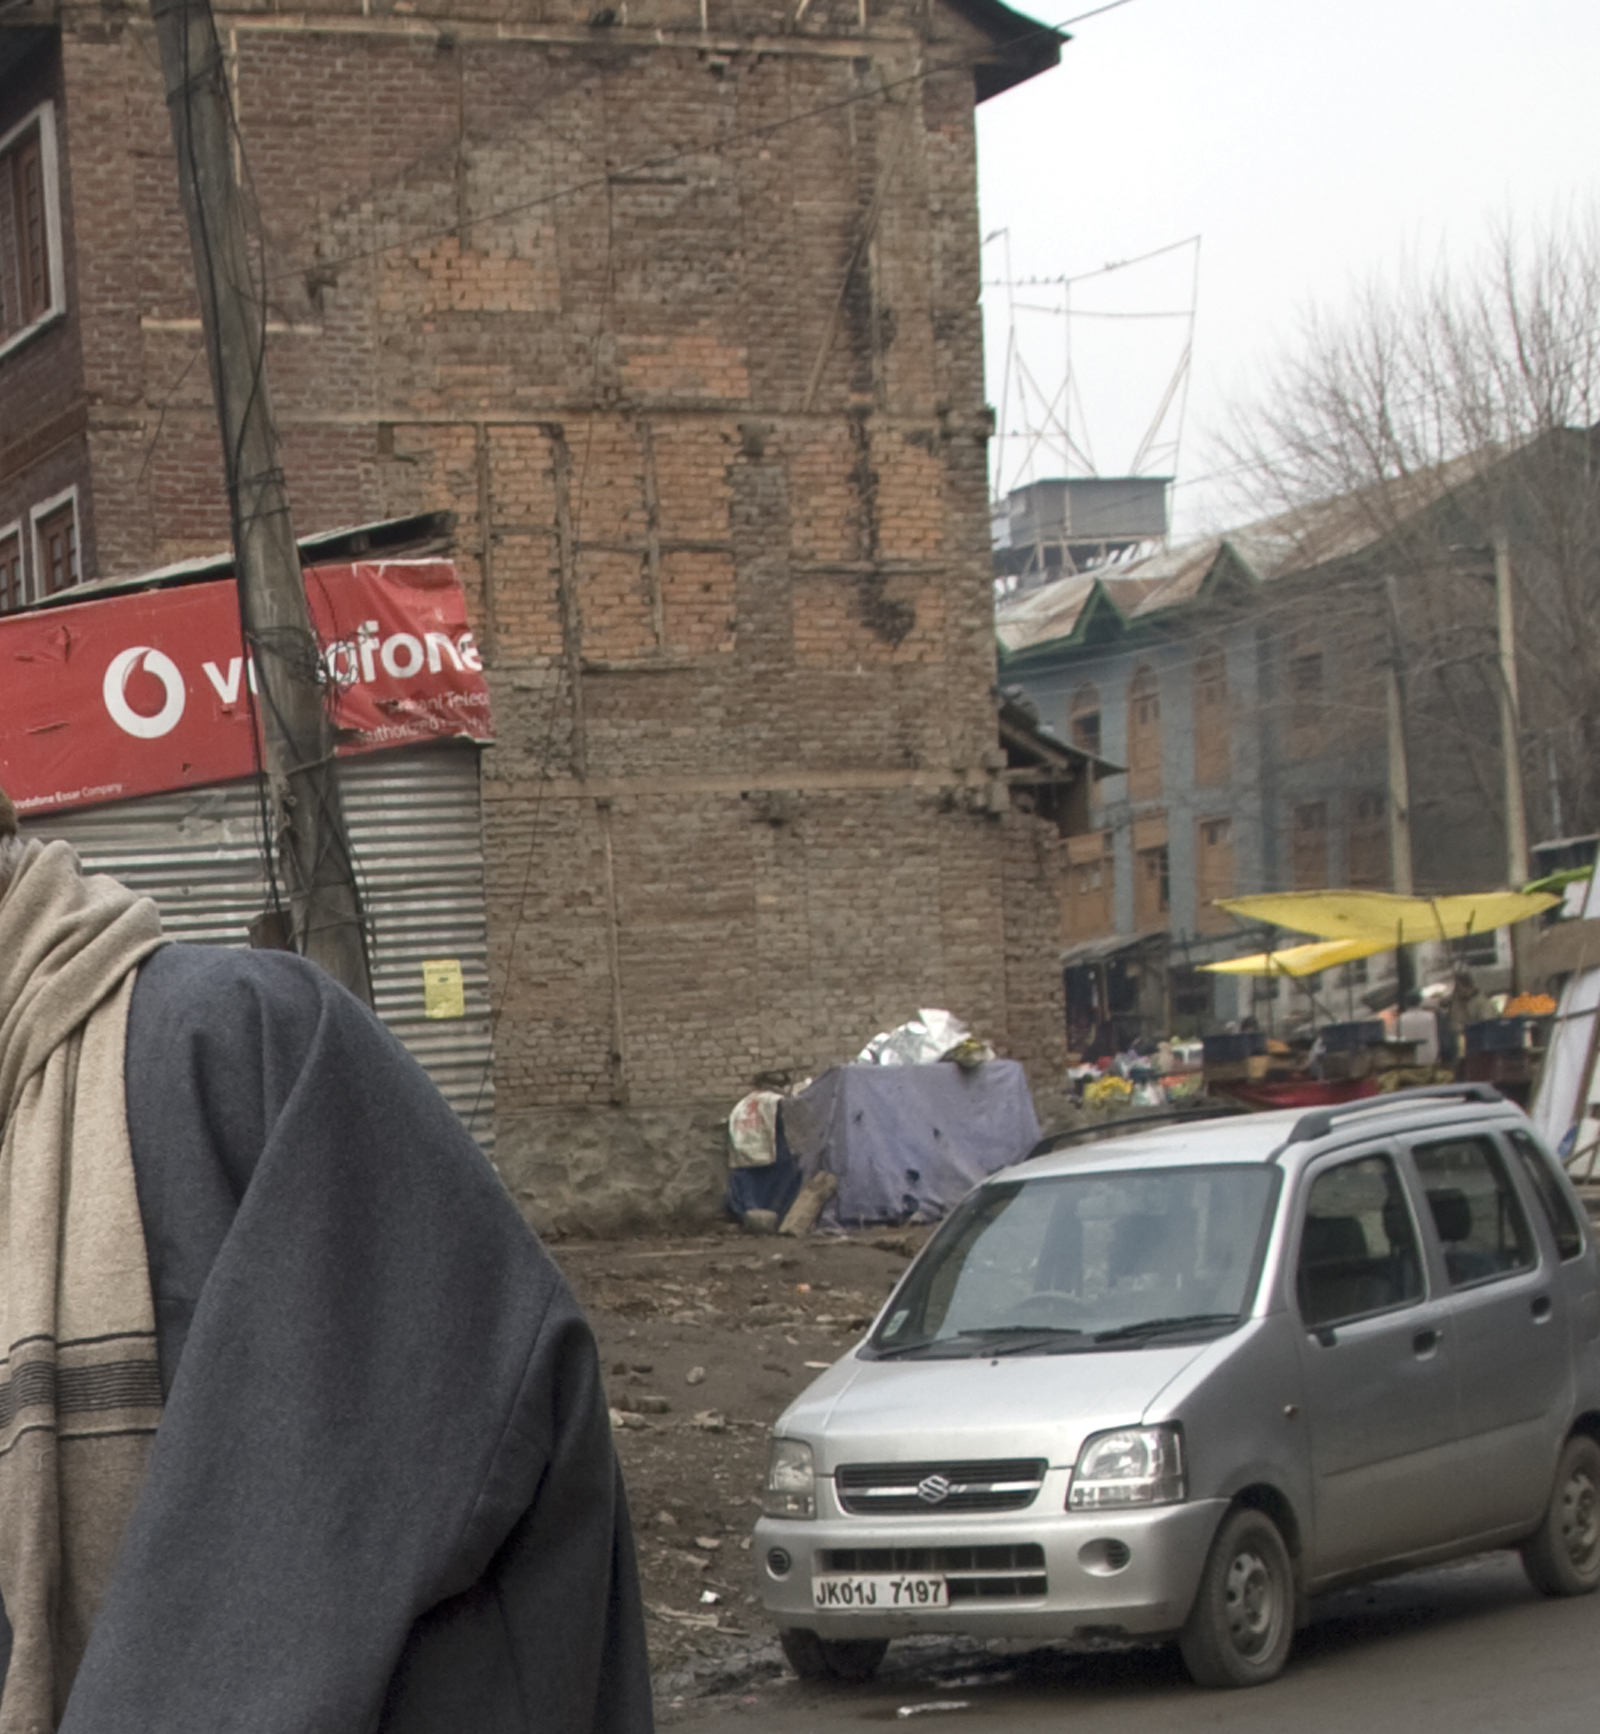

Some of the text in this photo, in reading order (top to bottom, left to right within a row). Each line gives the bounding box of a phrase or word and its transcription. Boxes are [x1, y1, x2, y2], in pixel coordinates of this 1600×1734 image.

[202, 620, 483, 705] vafone
[55, 790, 81, 802] Essar
[81, 782, 123, 797] Company
[816, 1579, 942, 1605] JK01J 7197
